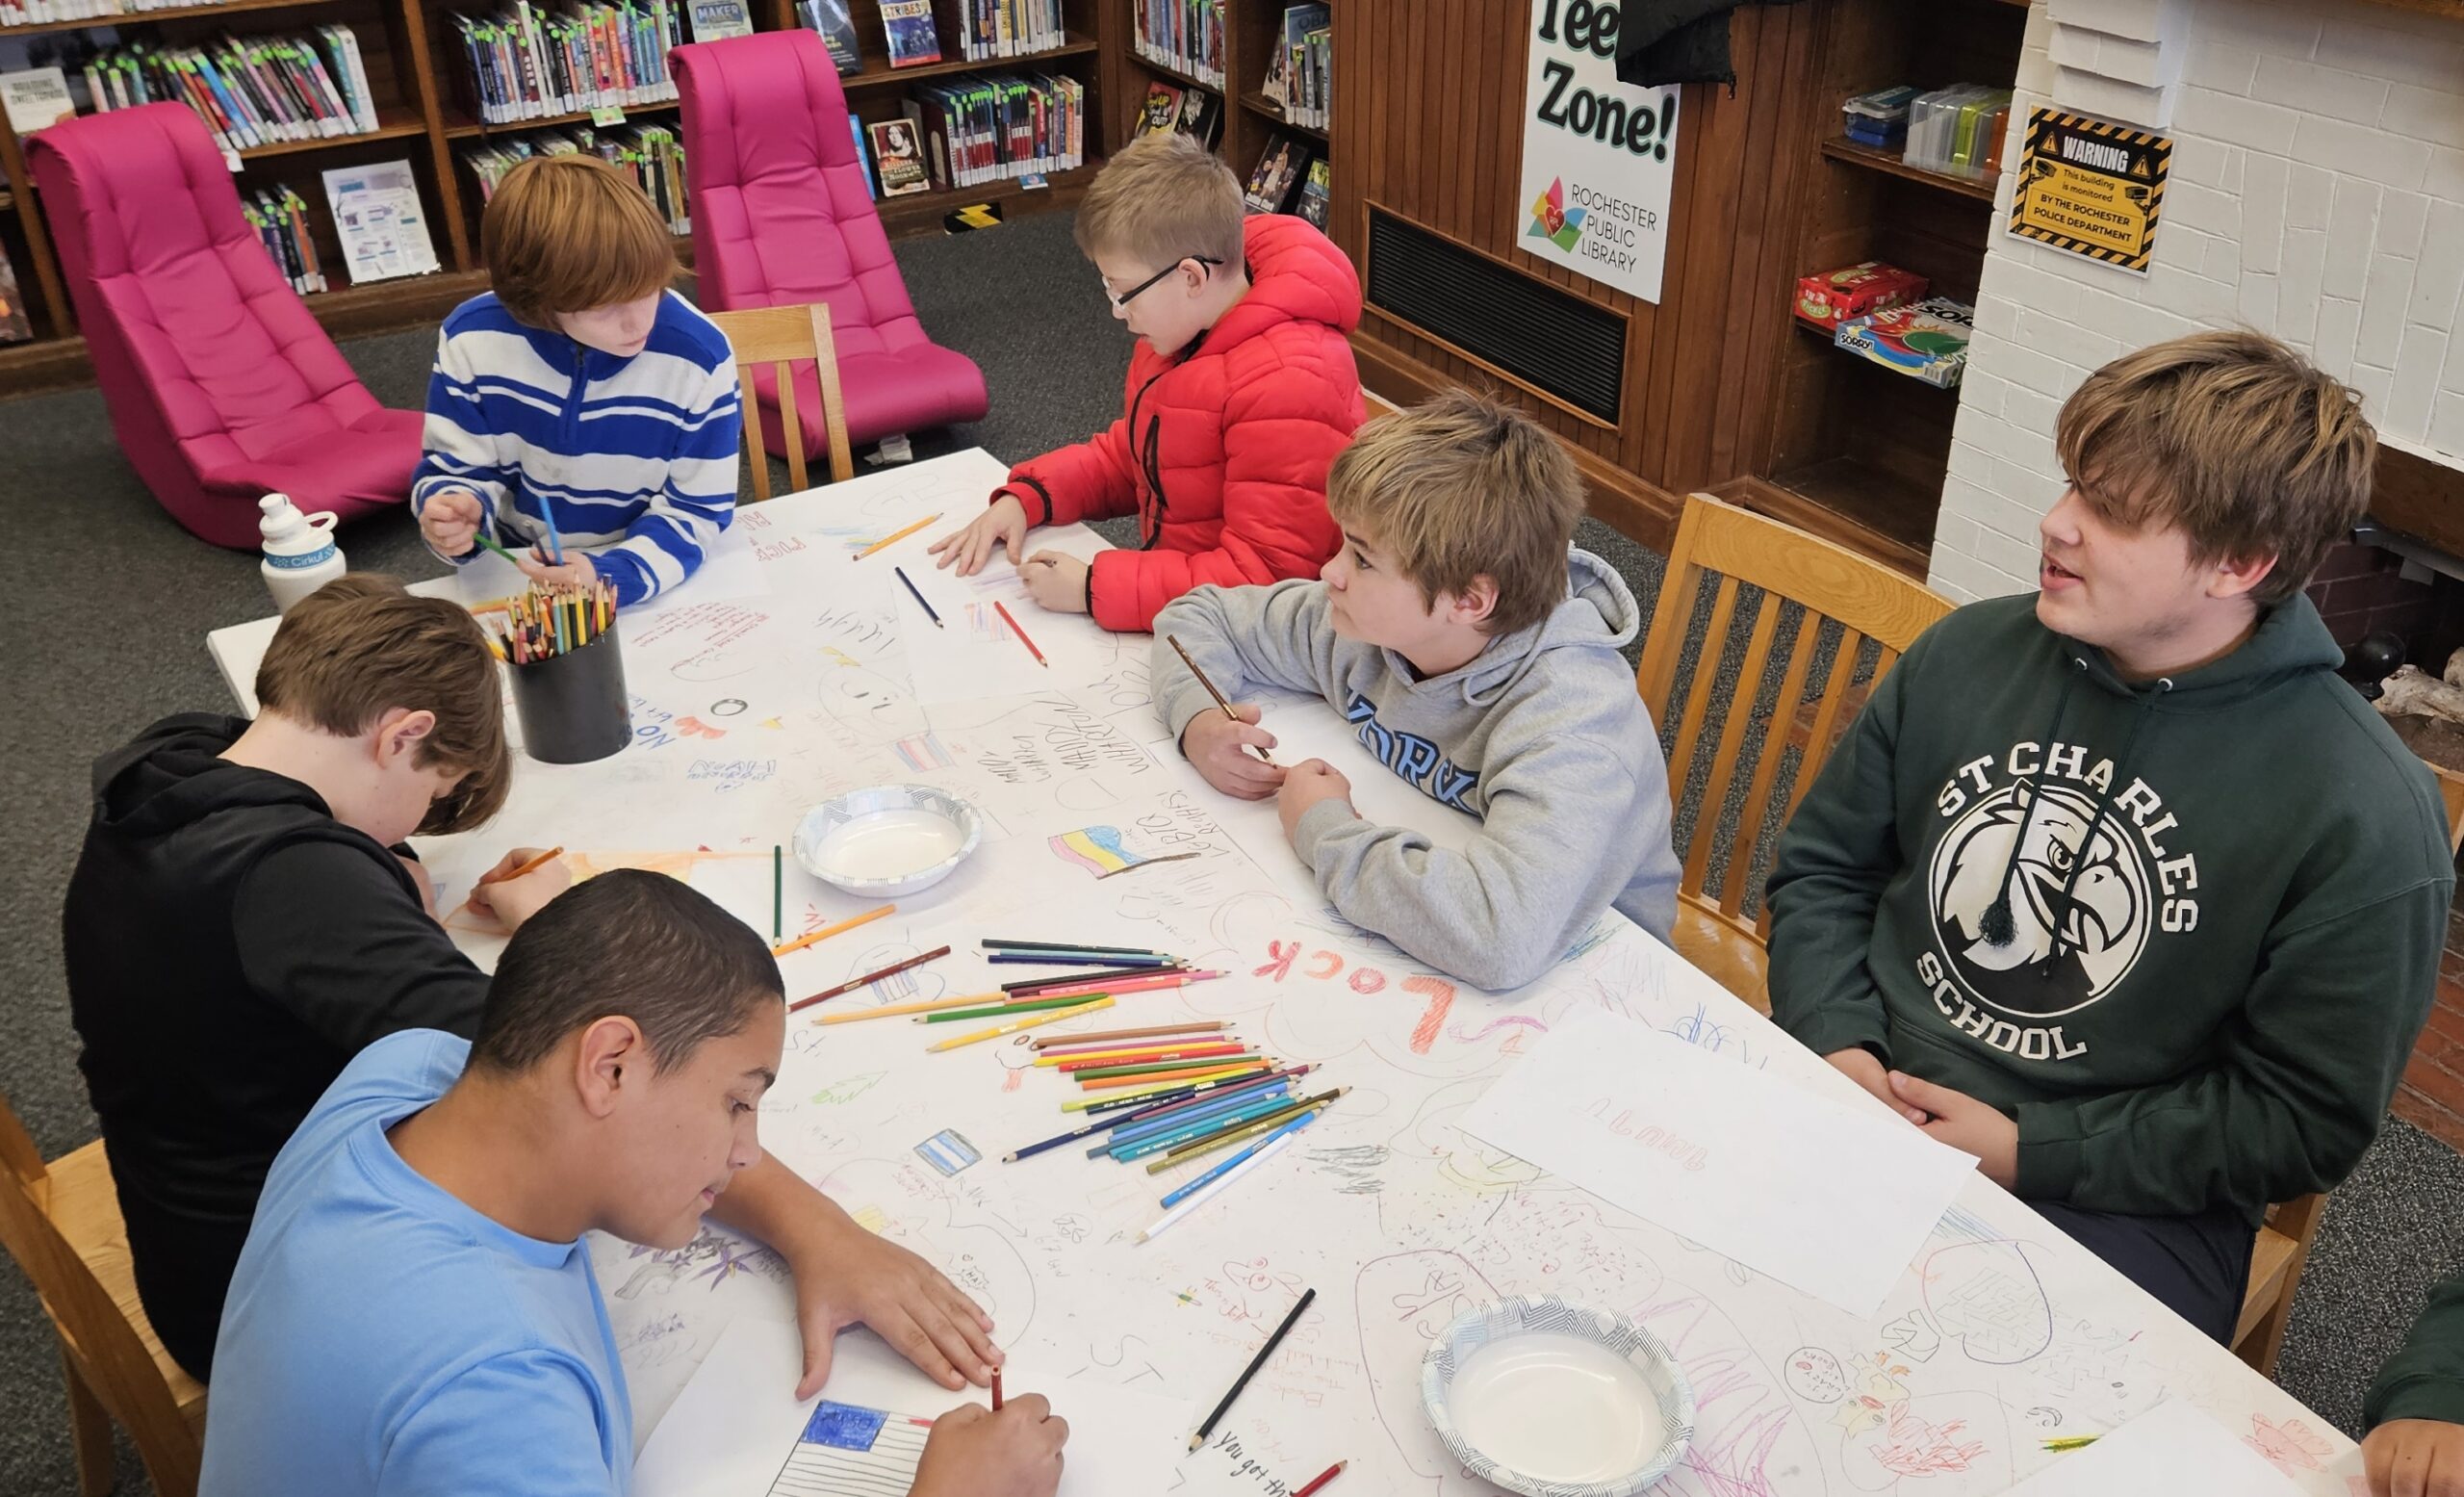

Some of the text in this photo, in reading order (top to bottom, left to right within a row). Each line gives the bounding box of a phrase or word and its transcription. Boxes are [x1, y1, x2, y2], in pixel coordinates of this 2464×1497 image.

[1539, 0, 1621, 58] Tee
[1537, 57, 1676, 163] Zone!
[2063, 136, 2130, 173] WARNING
[2062, 181, 2115, 203] is monitored
[2063, 168, 2116, 192] This building
[1571, 183, 1657, 231] ROCHESTER
[2034, 206, 2133, 243] POLICE DEPARTMENT
[2040, 194, 2131, 226] BY THE ROCHESTER
[1586, 214, 1636, 248] PUBLIC
[1581, 238, 1637, 274] LIBRARY
[1840, 333, 1875, 351] SORRY!
[291, 553, 323, 568] Cirkul
[1938, 741, 2200, 934] ST CHARLES
[1915, 950, 2089, 1062] SCHOOL
[1229, 1458, 1269, 1483] got
